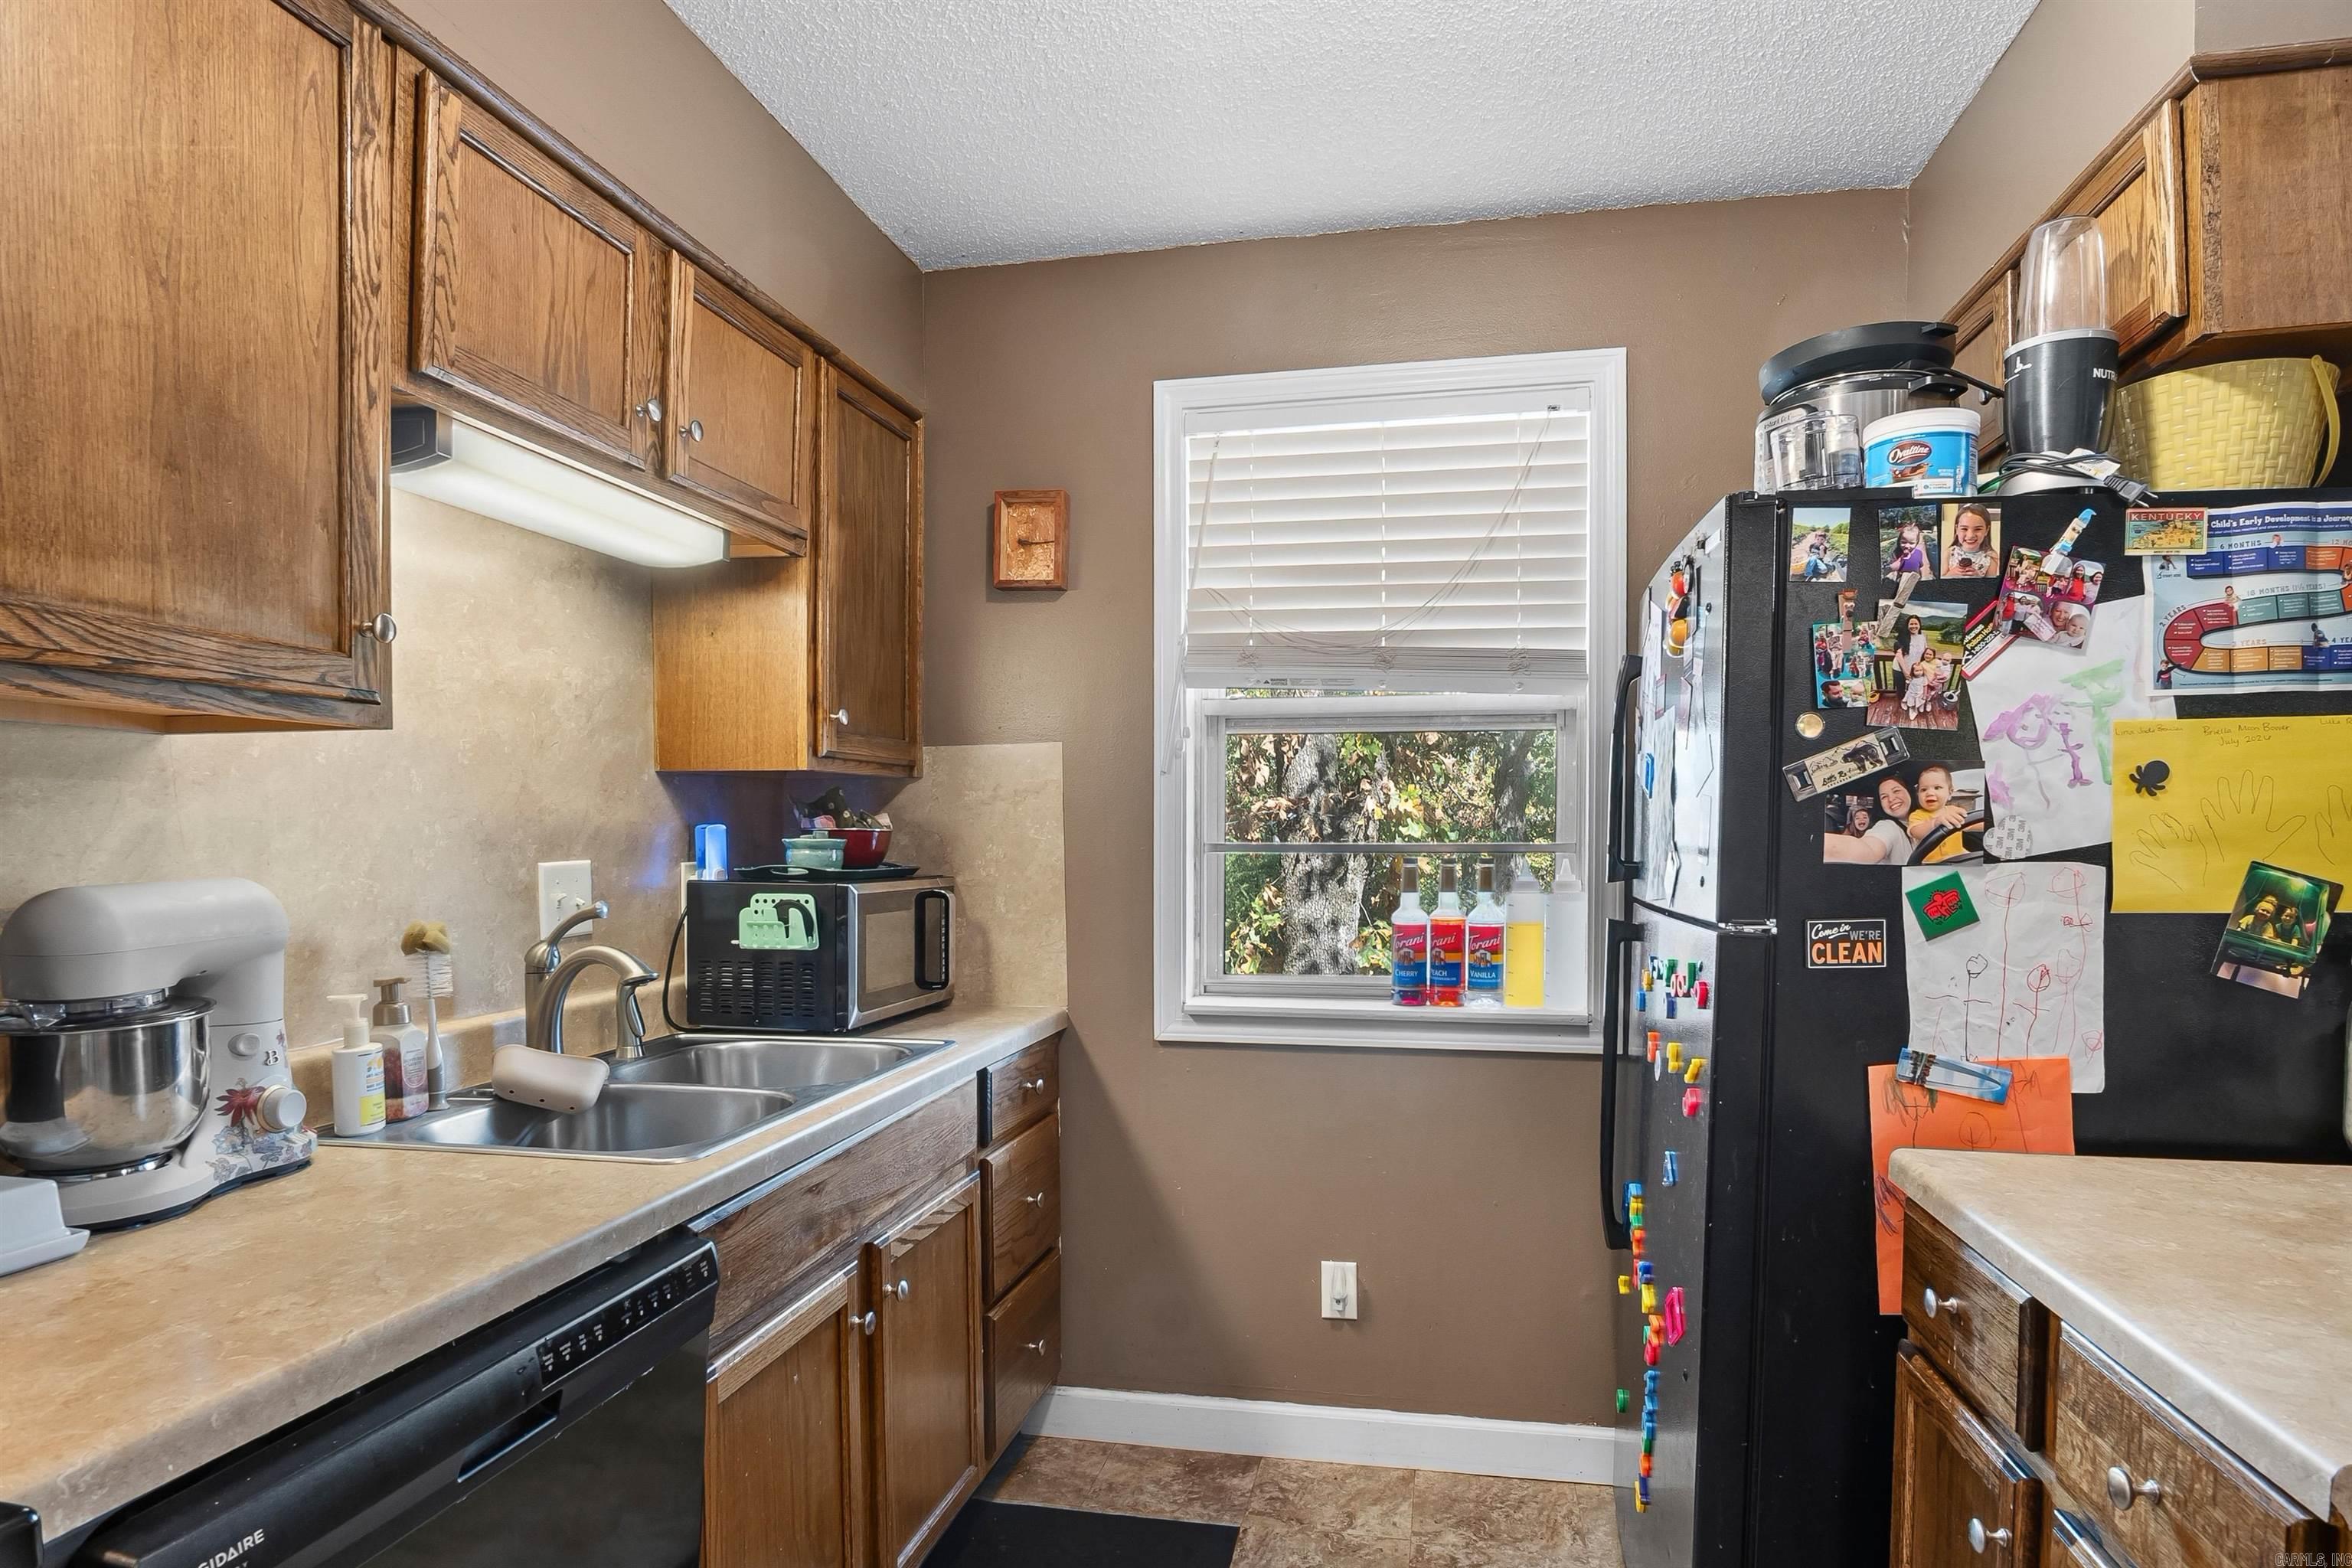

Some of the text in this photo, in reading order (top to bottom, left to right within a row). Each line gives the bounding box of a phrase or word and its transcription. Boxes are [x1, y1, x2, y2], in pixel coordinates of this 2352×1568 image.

[1889, 445, 1929, 463] Ovaltine
[2131, 512, 2202, 521] KENTUCKY
[2210, 520, 2237, 528] Child's
[2239, 515, 2262, 526] Early
[2265, 514, 2311, 524] Development
[2228, 540, 2262, 549] MONTHS
[2259, 585, 2290, 595] MONTHS
[2163, 605, 2187, 621] YEARS
[2219, 737, 2239, 748] July
[2018, 820, 2027, 832] 3M
[2007, 828, 2015, 841] 3M
[1997, 836, 2004, 849] 3M
[2016, 838, 2024, 851] 3M
[1811, 923, 1851, 939] Come in
[1850, 930, 1881, 941] WE'RE
[1393, 933, 1424, 949] Torani
[1432, 933, 1456, 948] rani
[1468, 934, 1501, 950] Torani
[1811, 942, 1882, 964] CLEAN
[1395, 969, 1418, 978] CHERRY
[1470, 969, 1496, 978] VANILLA
